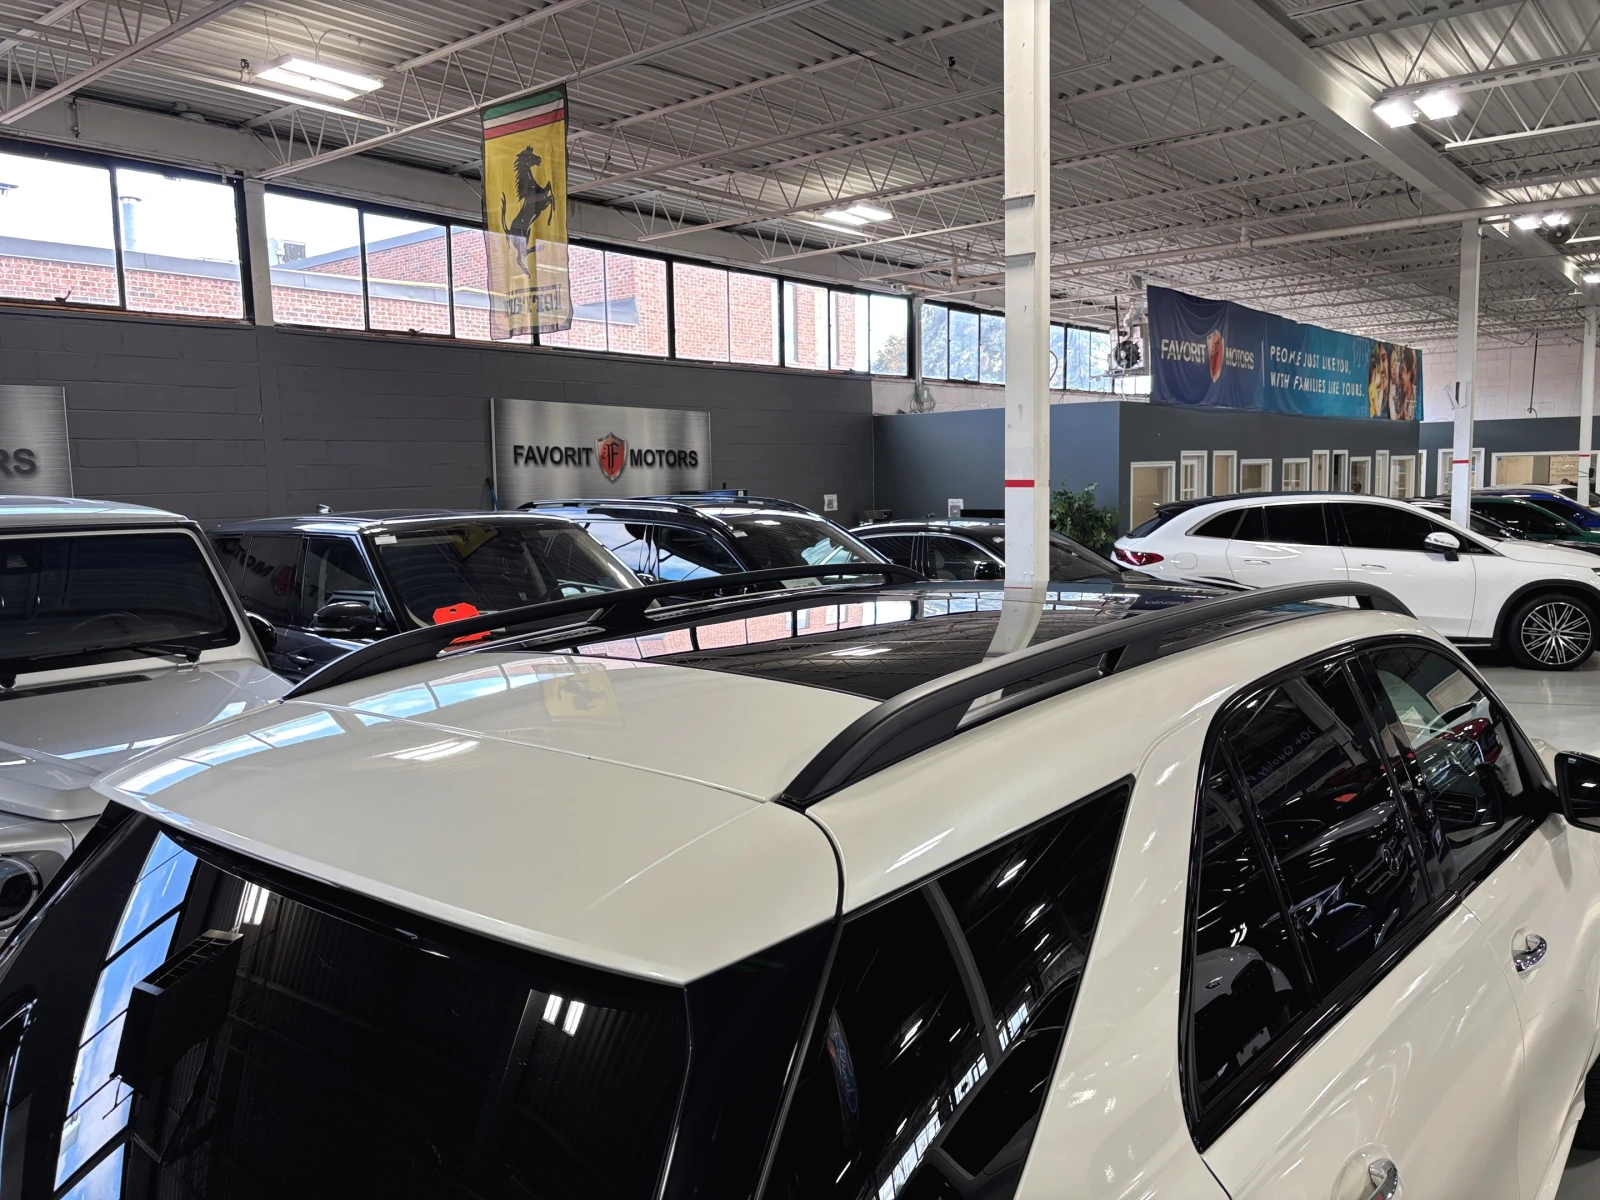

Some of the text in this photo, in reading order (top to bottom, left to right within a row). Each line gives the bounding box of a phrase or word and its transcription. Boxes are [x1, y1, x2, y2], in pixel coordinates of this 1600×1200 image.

[1161, 339, 1255, 370] FAVORIT MOTORS
[1303, 353, 1320, 369] JUST
[1322, 356, 1336, 371] LIKE
[1270, 371, 1291, 389] WITH
[1293, 375, 1326, 393] FAMILIES
[1328, 381, 1340, 395] LIKE
[513, 445, 593, 466] FAVORIT
[630, 448, 698, 467] MOTORS
